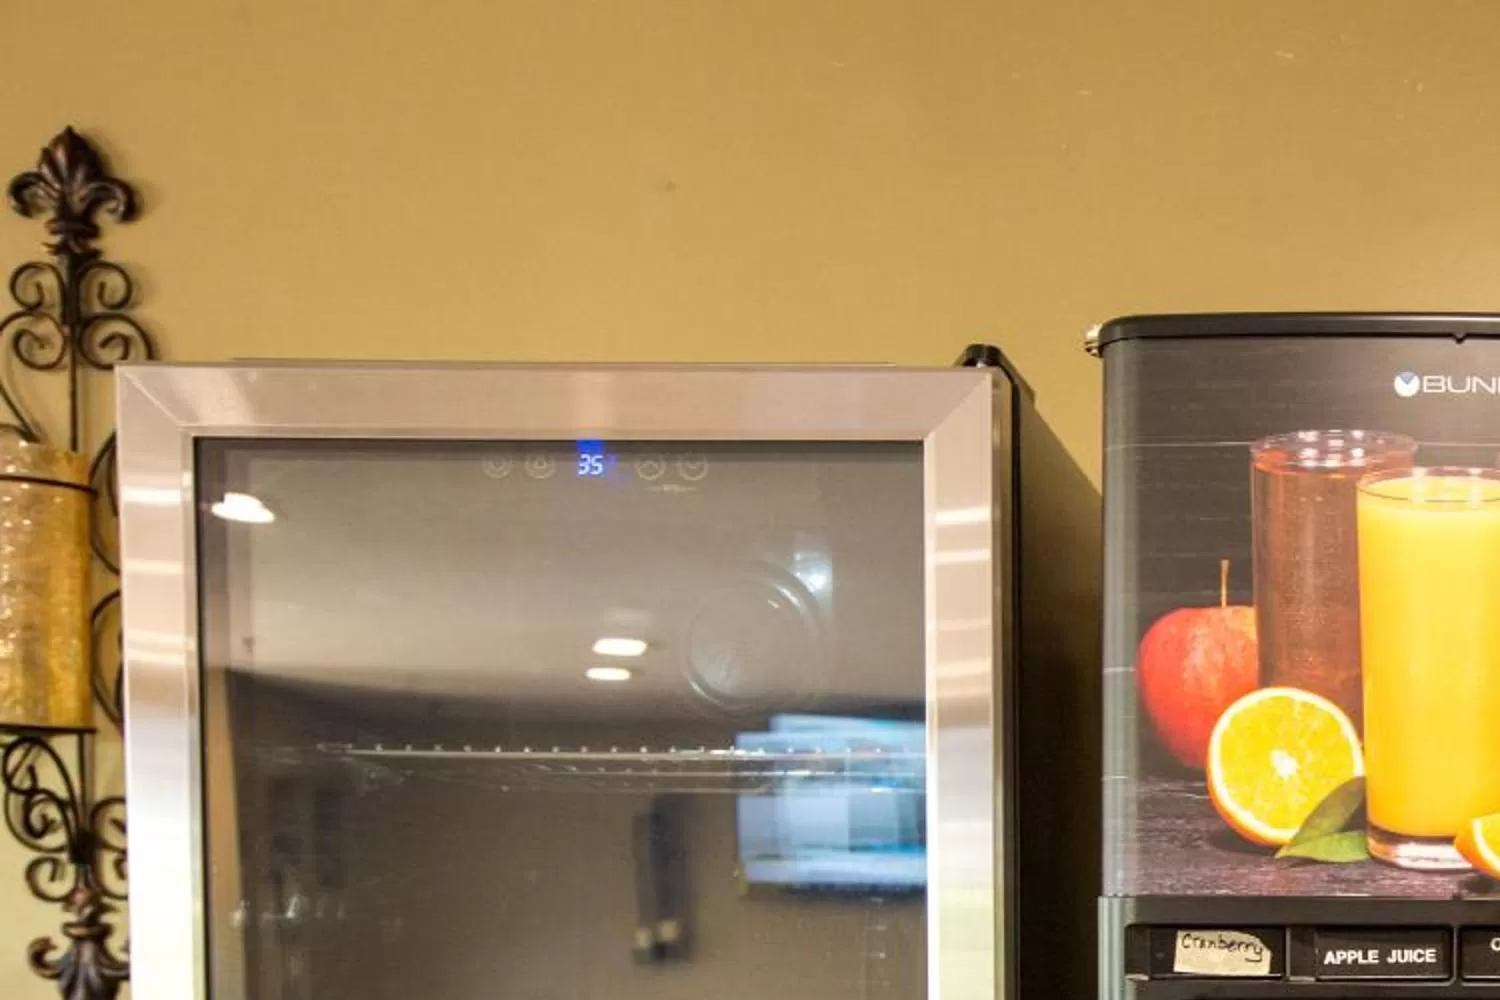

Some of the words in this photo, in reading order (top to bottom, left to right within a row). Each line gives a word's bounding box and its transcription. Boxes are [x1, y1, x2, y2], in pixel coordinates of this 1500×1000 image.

[577, 454, 604, 475] 35
[1181, 932, 1265, 962] Cranberry
[1323, 949, 1380, 965] APPLE
[1386, 948, 1437, 964] JUICE
